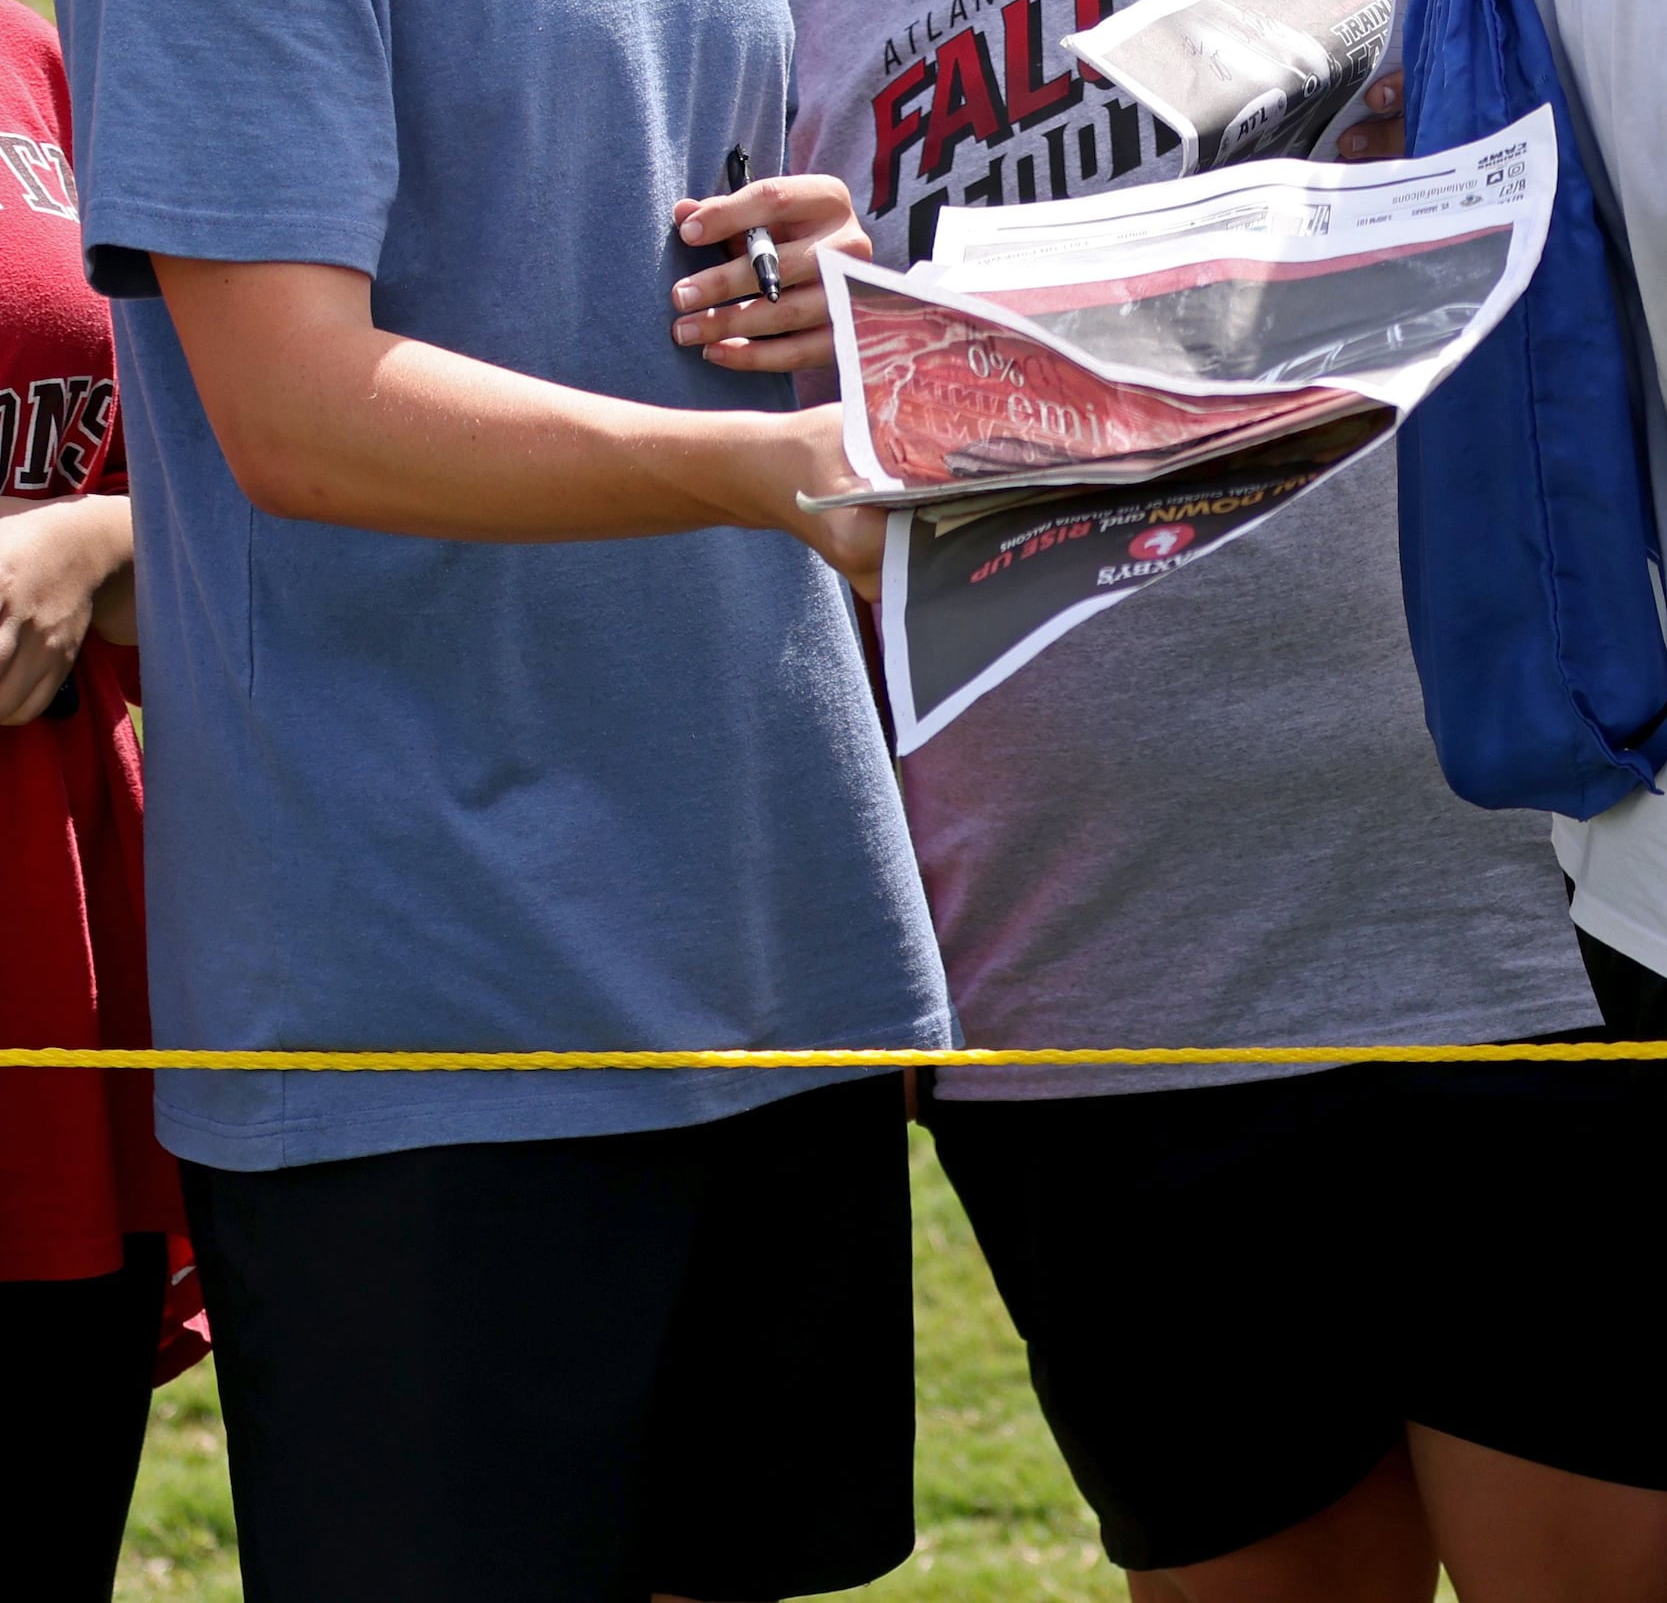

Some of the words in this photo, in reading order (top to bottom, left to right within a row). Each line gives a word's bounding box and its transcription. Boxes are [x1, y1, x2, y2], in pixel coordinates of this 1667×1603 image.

[1237, 105, 1269, 142] ATL
[1055, 508, 1114, 527] ATLANTA
[1100, 500, 1146, 533] and
[1000, 520, 1052, 553] FALCONS
[1020, 520, 1093, 562] RISE
[968, 550, 1014, 584] UP
[1096, 549, 1194, 586] AXBY'S
